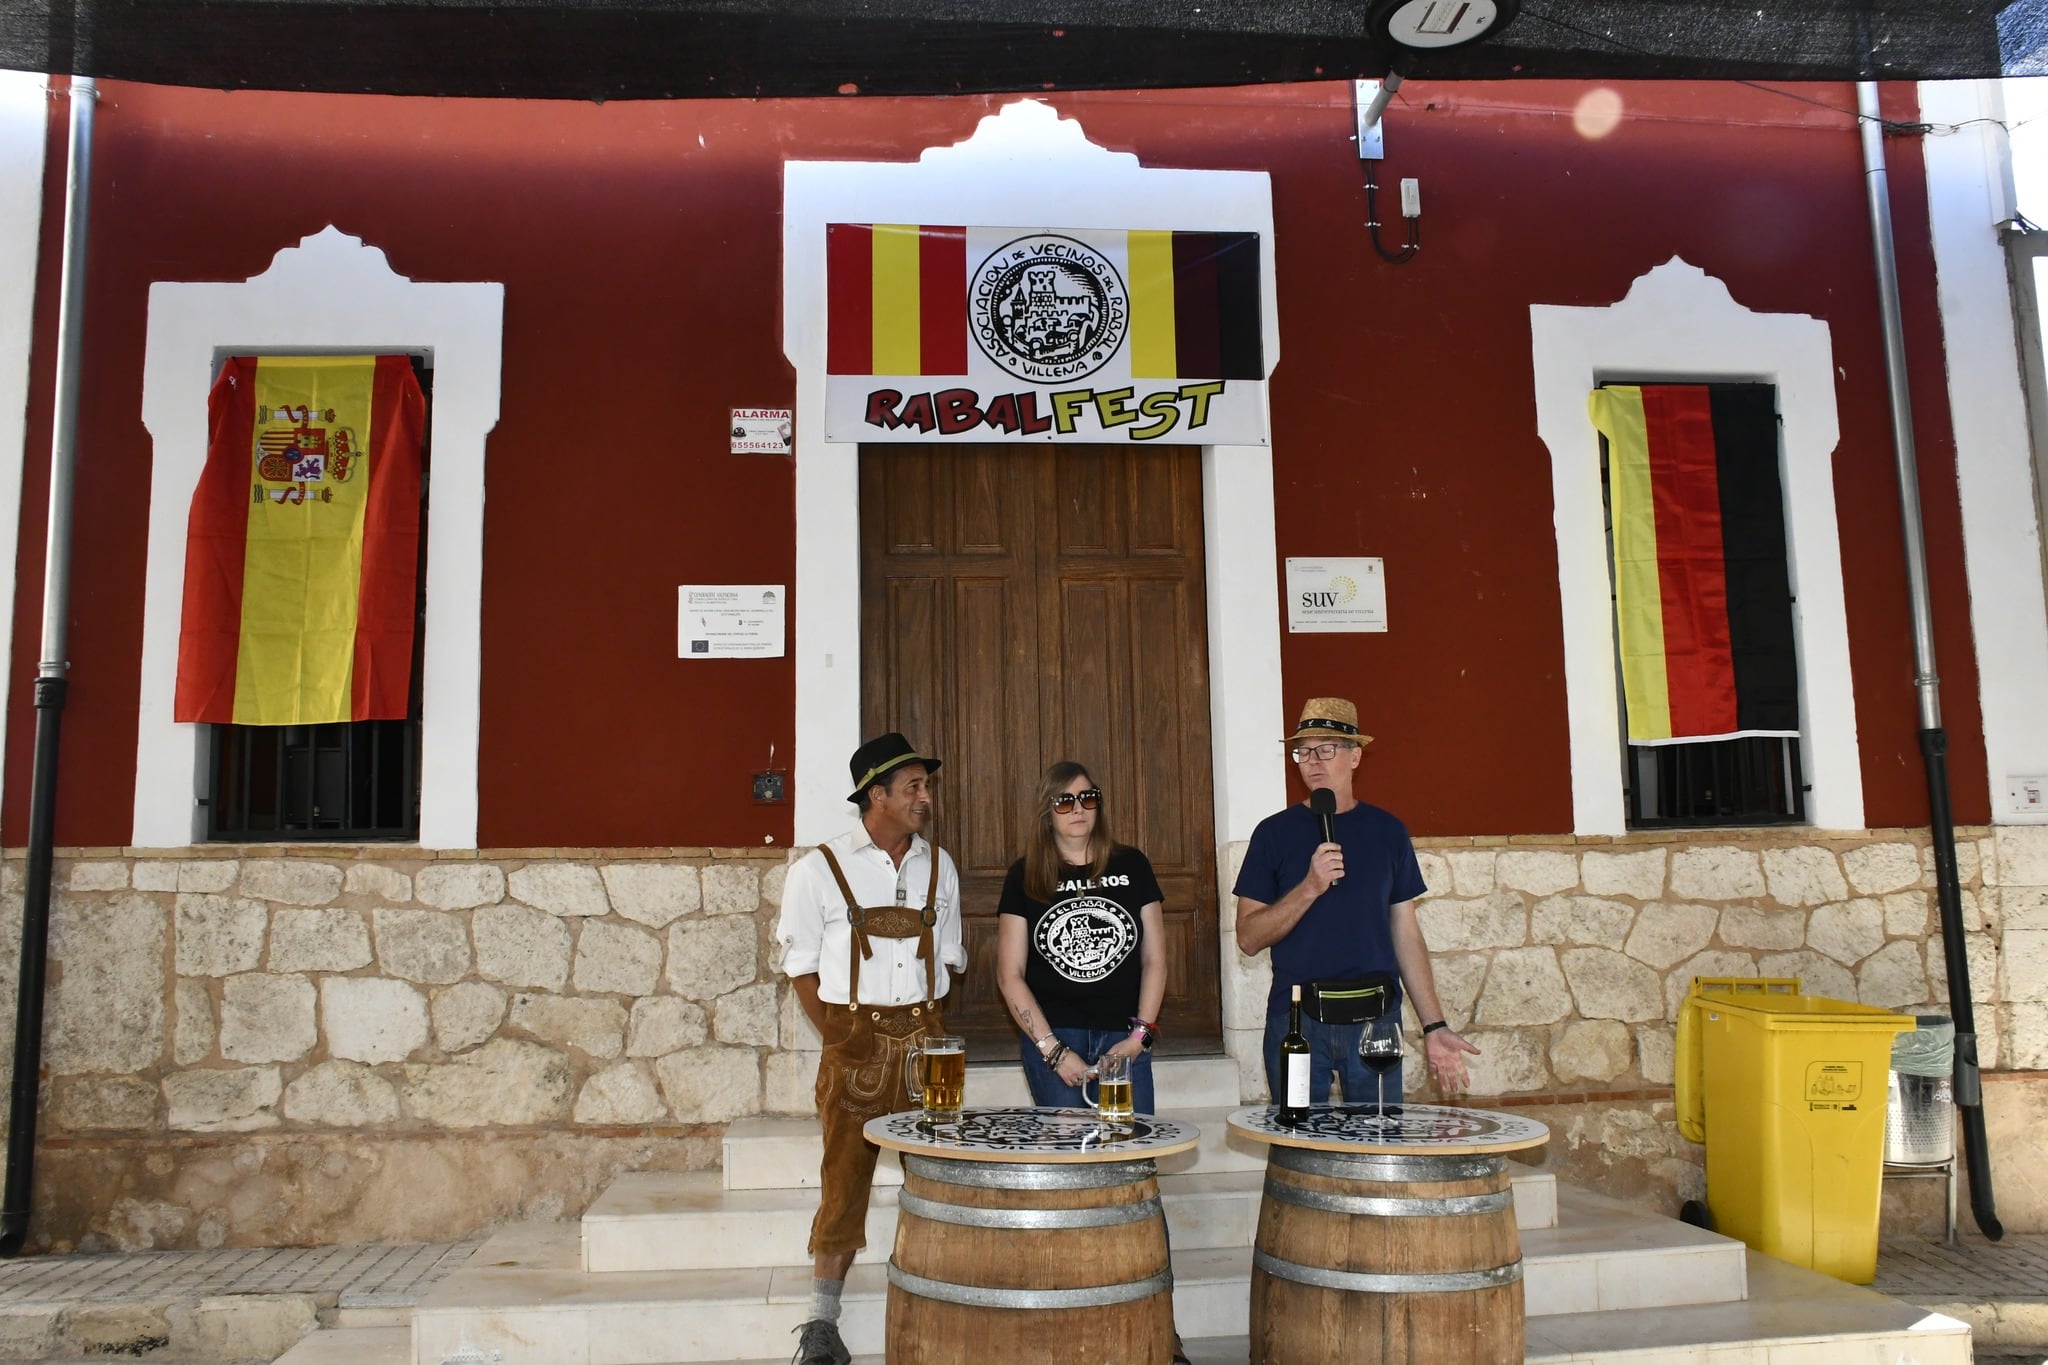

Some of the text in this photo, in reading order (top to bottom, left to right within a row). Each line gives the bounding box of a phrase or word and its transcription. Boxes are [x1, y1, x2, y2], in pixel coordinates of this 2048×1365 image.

[976, 243, 1124, 358] ASOCIACION DE VECINOS DEL RABAL
[1022, 361, 1088, 377] VILLENA
[732, 410, 790, 418] ALARMA
[864, 381, 1226, 440] RABALFEST
[1056, 874, 1130, 892] BALEROS
[1056, 900, 1109, 915] EL RABAL
[1068, 967, 1108, 978] VILLENA
